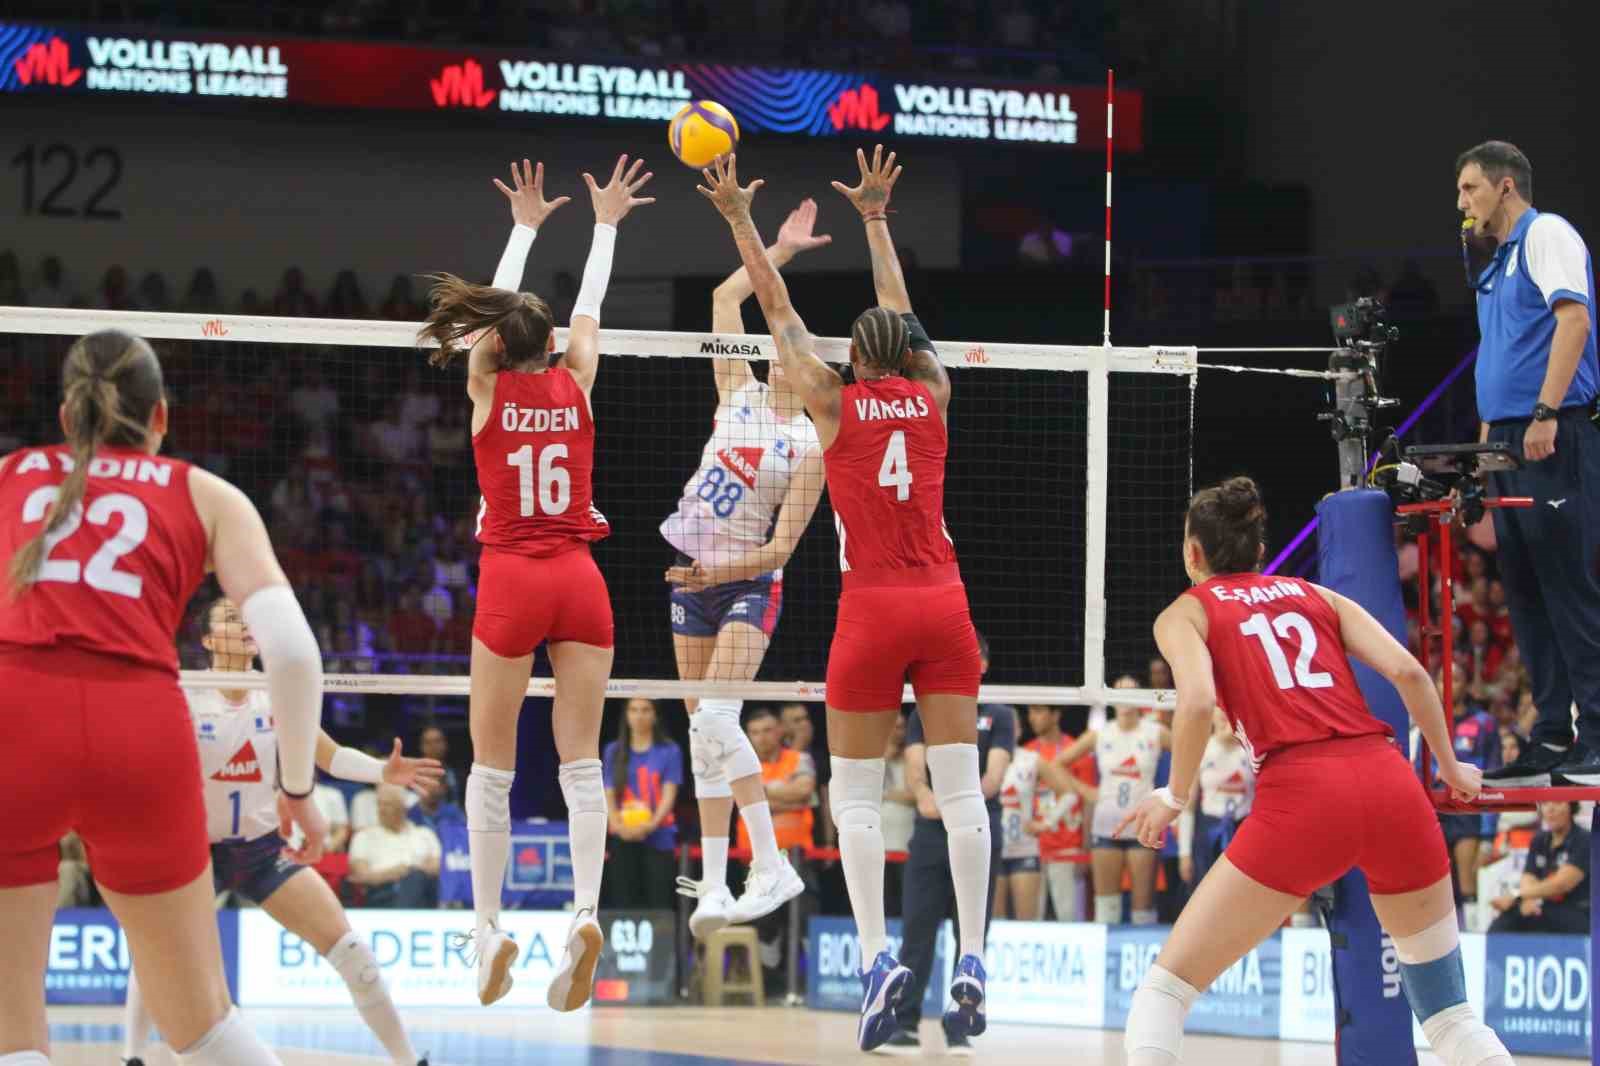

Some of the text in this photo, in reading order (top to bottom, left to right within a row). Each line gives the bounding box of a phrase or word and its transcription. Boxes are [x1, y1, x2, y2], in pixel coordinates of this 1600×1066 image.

[86, 37, 288, 74] VOLLEYBALL
[86, 67, 288, 98] NATIONS LEAGUE
[499, 60, 692, 99] VOLLEYBALL
[499, 90, 600, 115] NATIONS
[894, 84, 1078, 121] VOLLEYBALL
[894, 113, 1077, 144] NATIONS LEAGUE
[11, 143, 124, 219] 122
[502, 402, 580, 432] ÖZDEN
[855, 395, 929, 421] VARGAS
[507, 443, 571, 517] 16
[878, 430, 913, 501] 4
[697, 466, 743, 518] 88
[22, 485, 148, 599] 22
[1239, 611, 1334, 690] 12
[228, 790, 241, 835] 1
[1504, 955, 1591, 1011] BIOD
